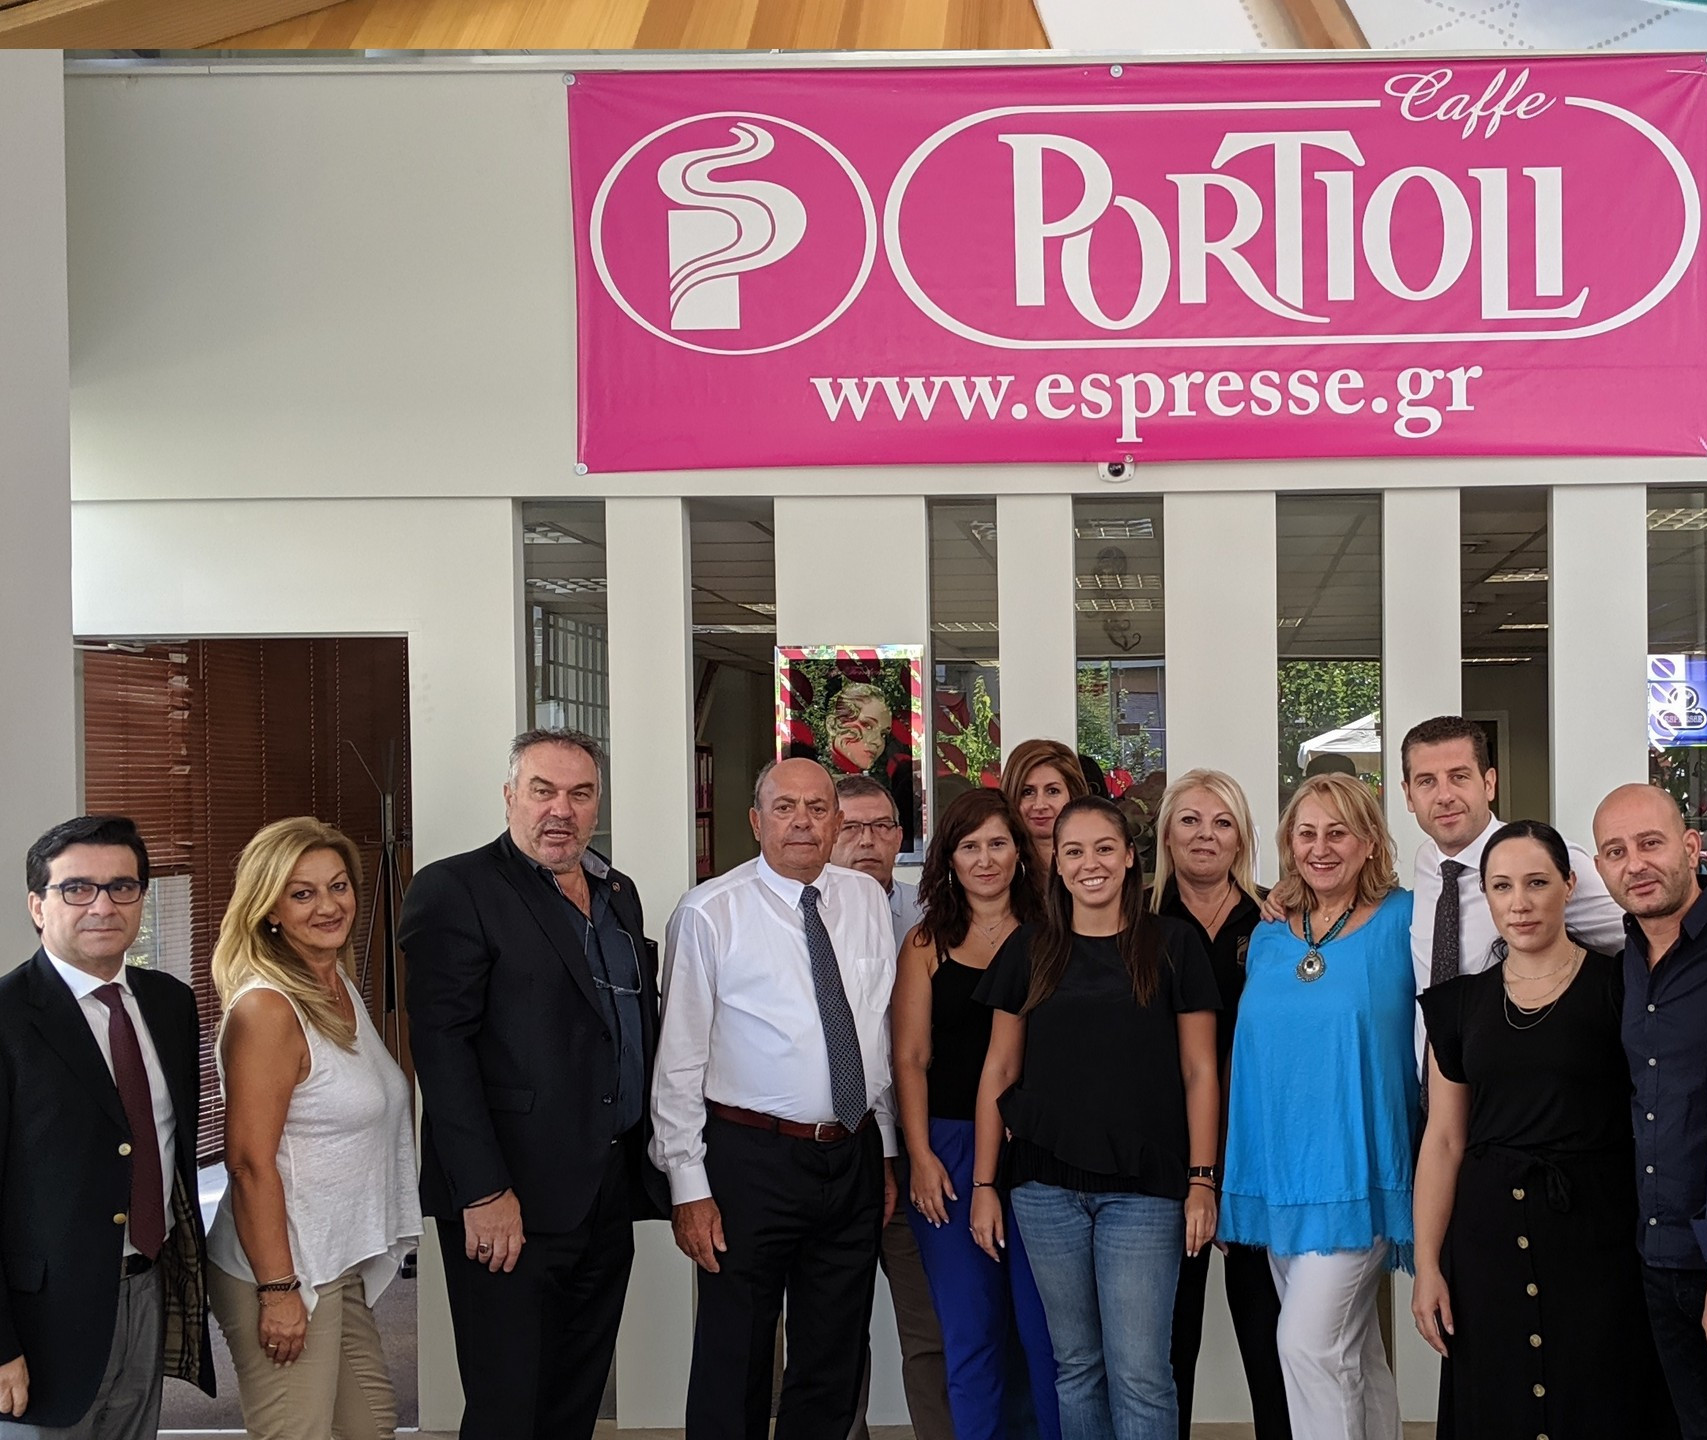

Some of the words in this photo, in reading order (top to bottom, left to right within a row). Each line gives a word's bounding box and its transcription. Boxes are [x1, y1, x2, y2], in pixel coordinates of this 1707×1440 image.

[1384, 67, 1557, 140] Caffe
[996, 130, 1591, 331] PORTIOLI
[809, 364, 1484, 444] www.espresse.gr
